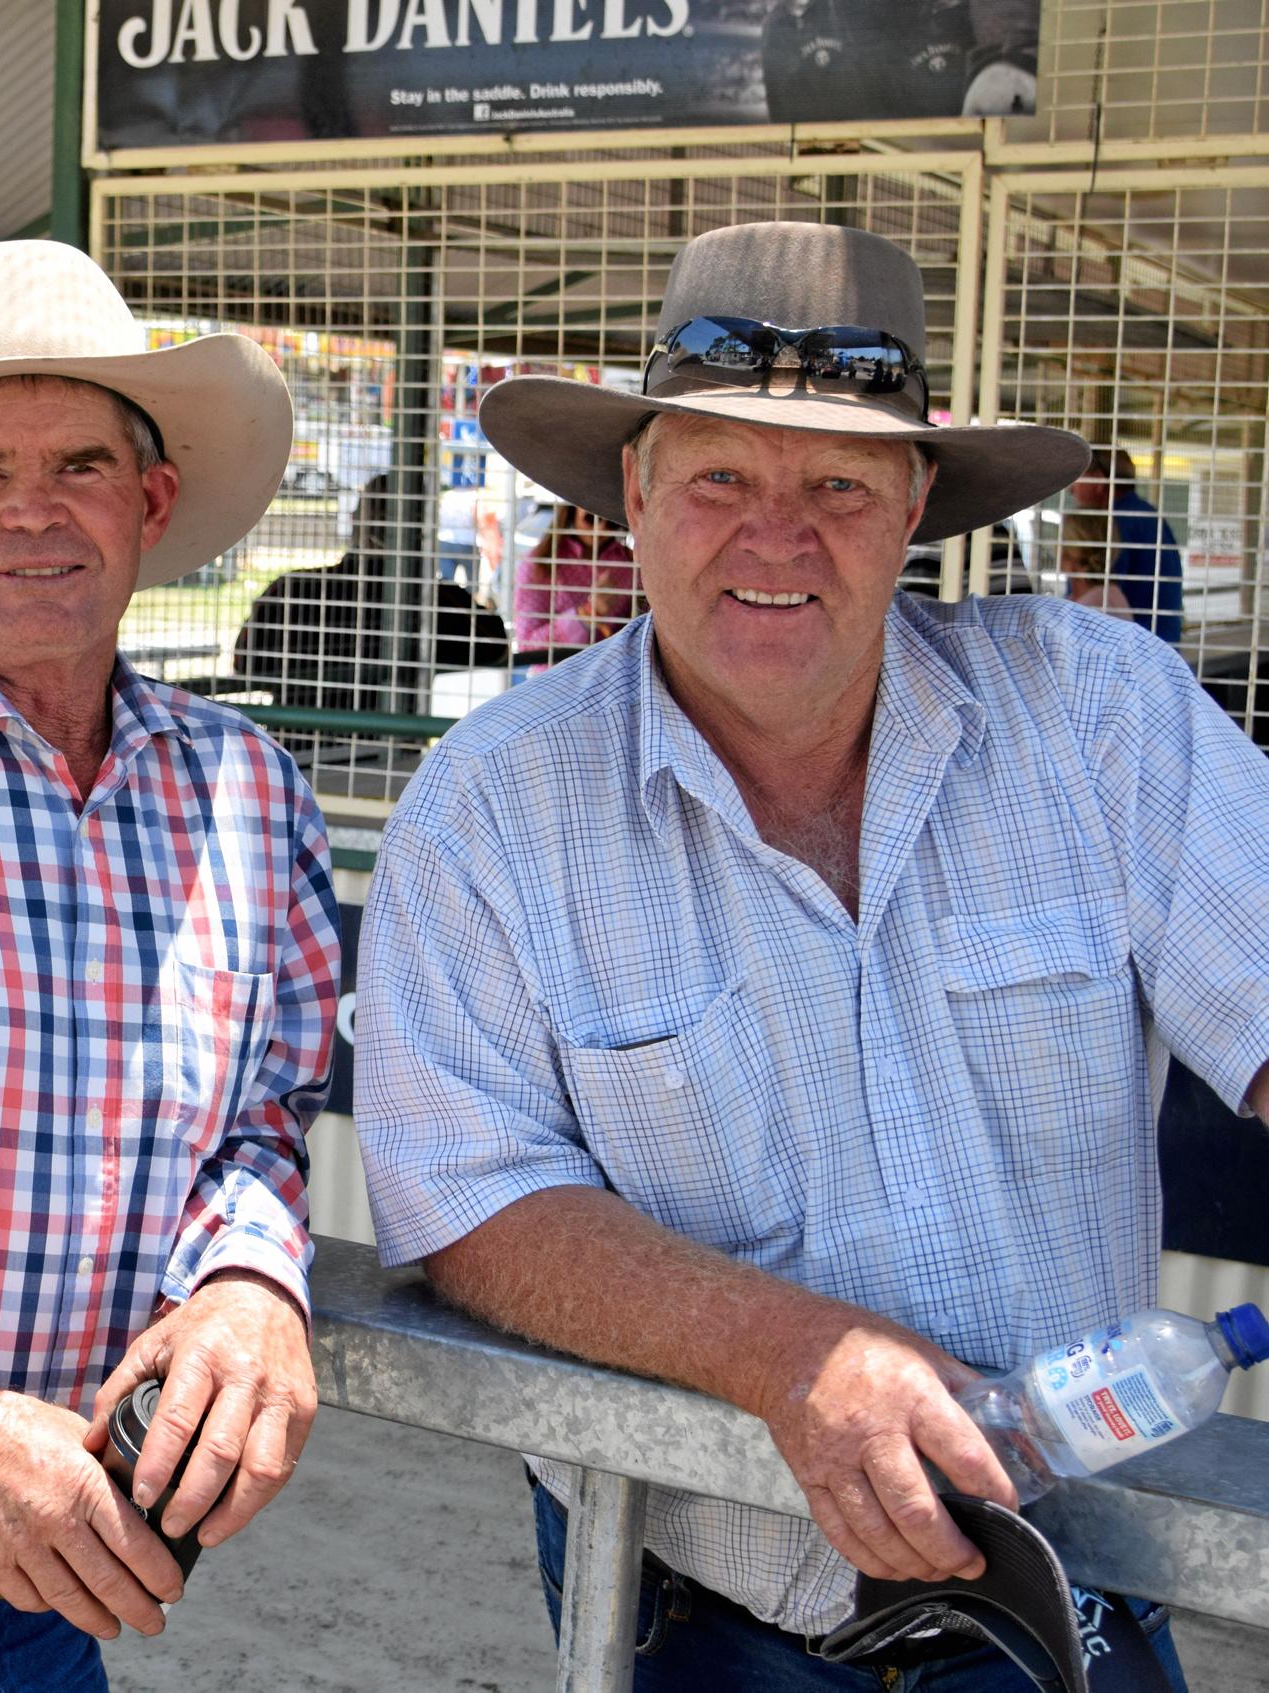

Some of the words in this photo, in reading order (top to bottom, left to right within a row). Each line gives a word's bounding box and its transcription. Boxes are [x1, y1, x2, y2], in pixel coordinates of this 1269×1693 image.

[117, 0, 320, 69] JACK
[389, 89, 424, 107] Stay
[426, 88, 442, 104] in
[444, 87, 470, 103] the
[472, 84, 526, 102] saddle.
[529, 82, 571, 99] Drink
[573, 77, 664, 99] responsibly.
